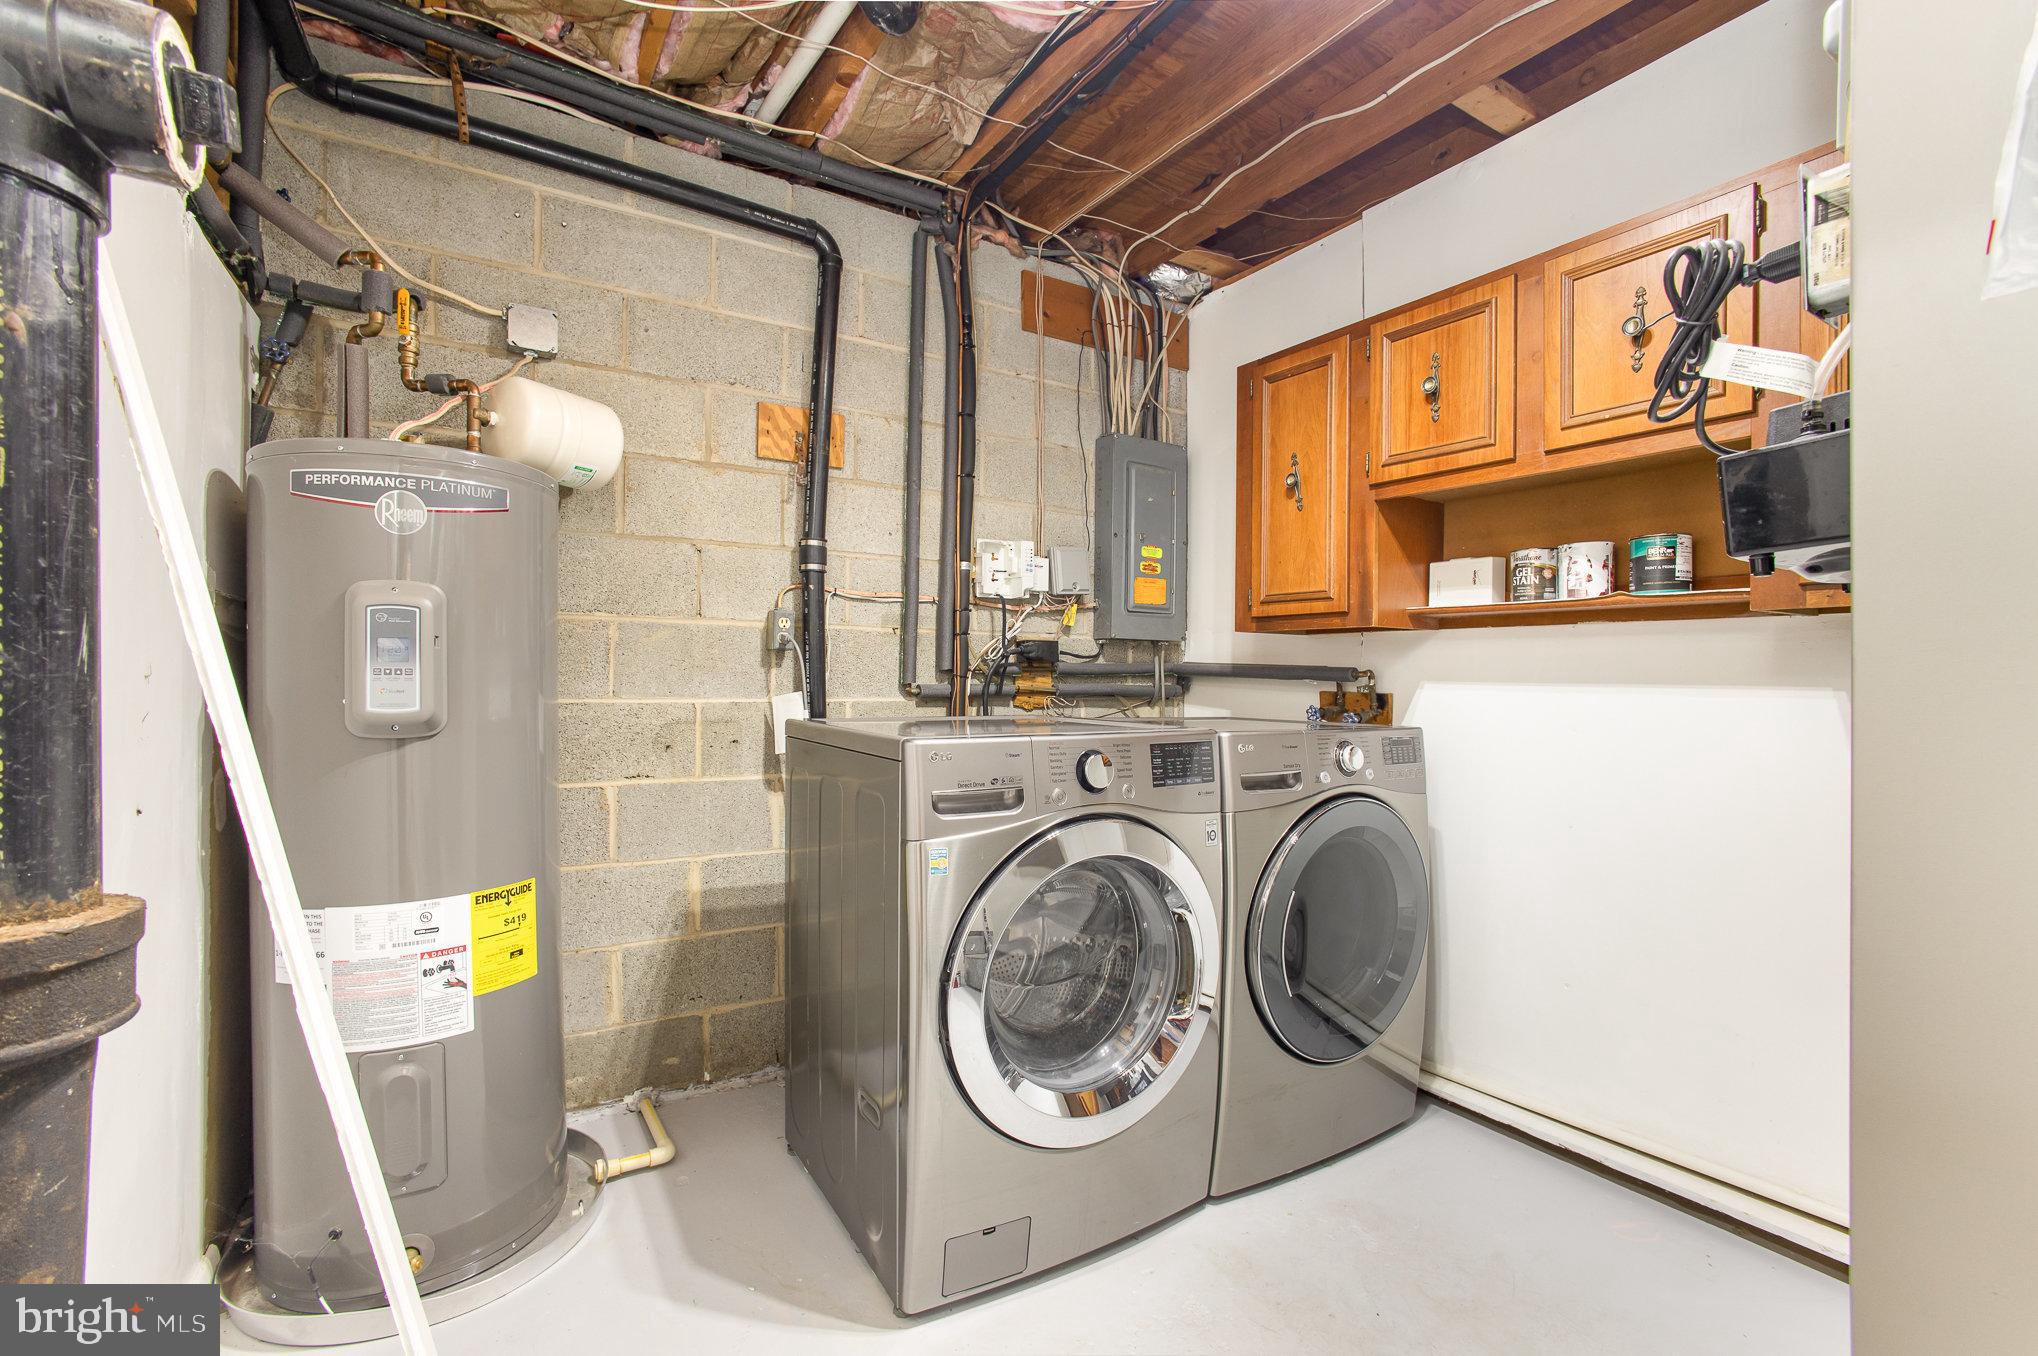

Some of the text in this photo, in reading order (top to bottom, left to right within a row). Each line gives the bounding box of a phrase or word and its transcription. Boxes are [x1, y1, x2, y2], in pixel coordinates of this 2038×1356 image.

[305, 474, 494, 500] PERFORMANCE PLATINUM
[381, 498, 425, 528] Rheem
[1516, 567, 1533, 576] GEL
[1512, 576, 1540, 586] STAIN
[432, 946, 464, 958] DANGER
